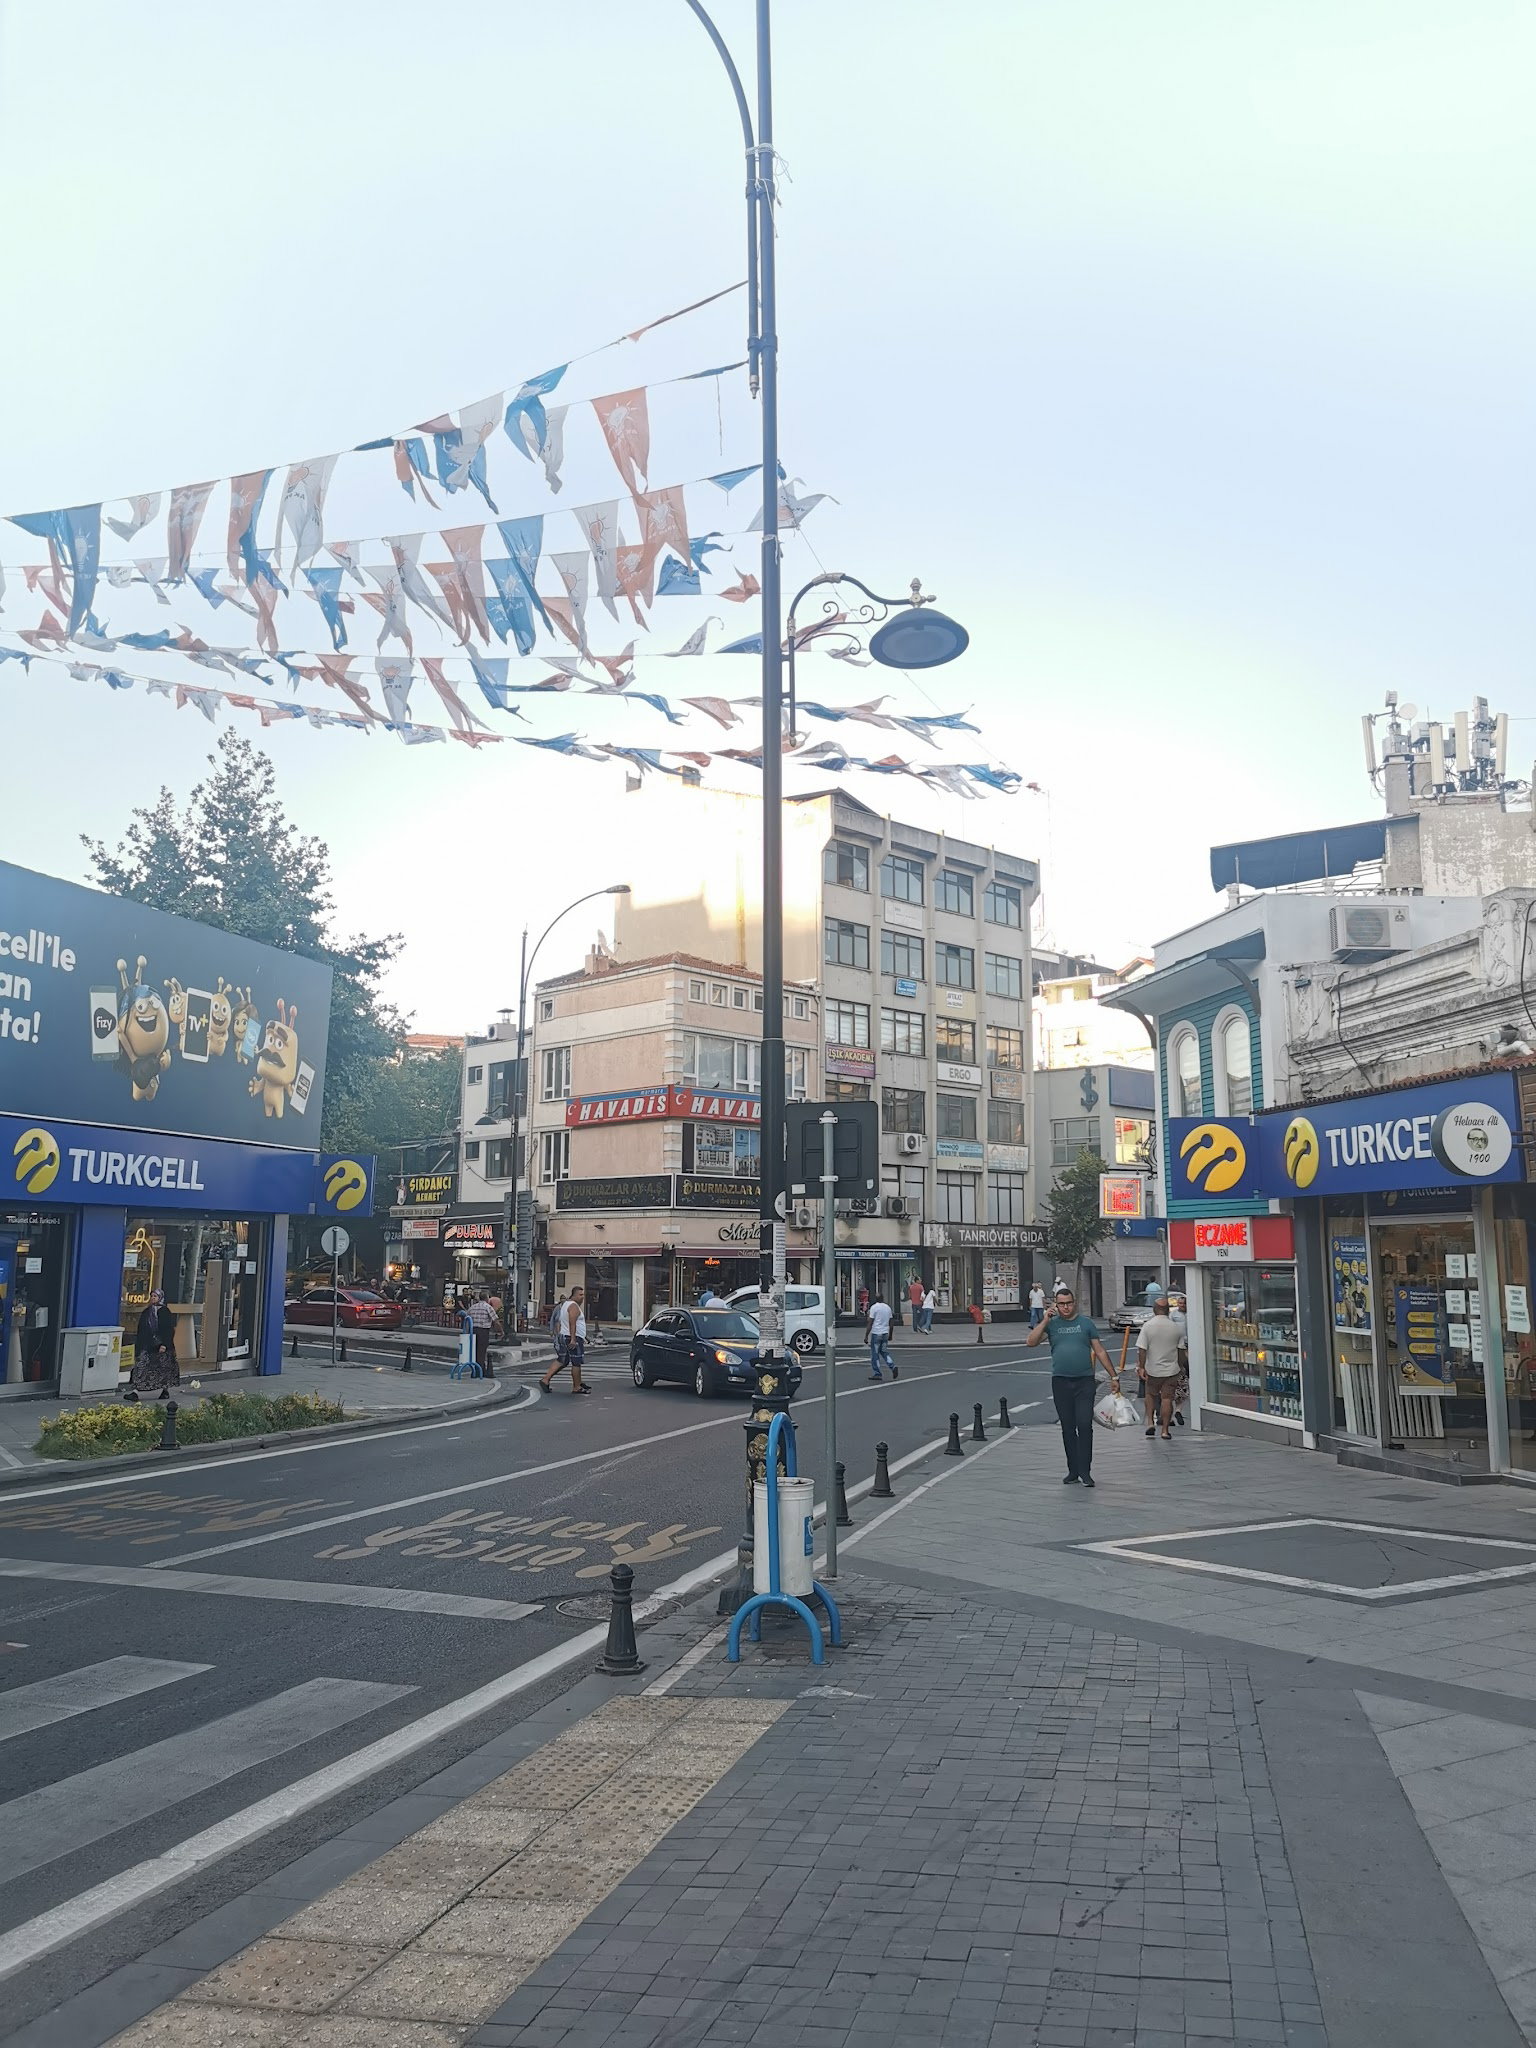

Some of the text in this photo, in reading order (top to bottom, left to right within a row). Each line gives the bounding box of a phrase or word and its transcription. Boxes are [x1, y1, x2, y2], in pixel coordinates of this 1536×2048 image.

[96, 1016, 113, 1031] fizy
[949, 1067, 971, 1081] ERGO
[579, 1095, 666, 1121] HAVADİS
[1486, 1114, 1500, 1127] Ali
[1325, 1115, 1438, 1168] TURKCE
[1468, 1152, 1491, 1164] 1900
[68, 1148, 205, 1191] TURKCELL
[694, 1182, 753, 1196] DURMAZLAR
[1019, 1231, 1045, 1244] GIDA
[1195, 1222, 1248, 1247] ECZANE
